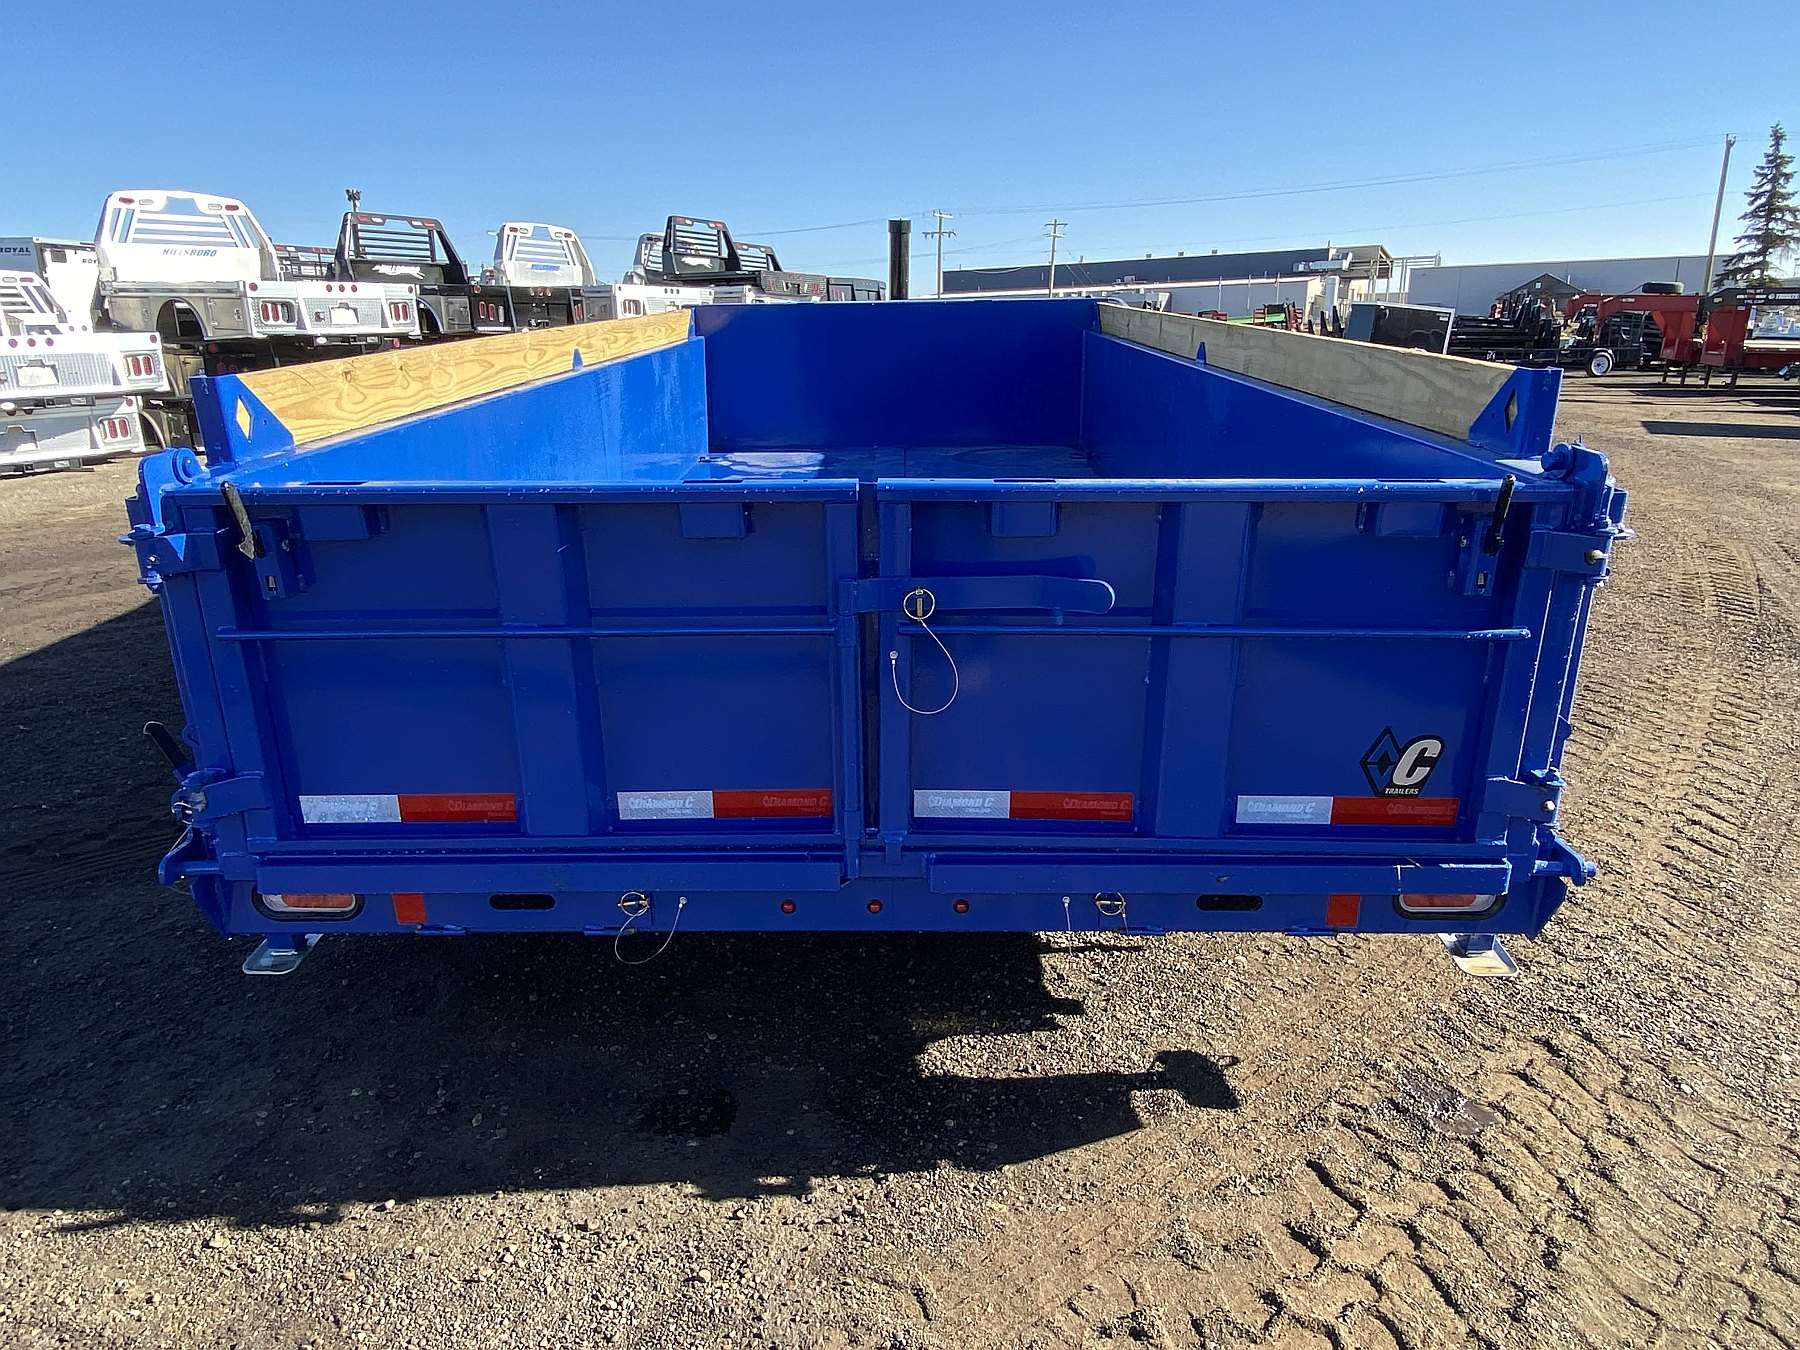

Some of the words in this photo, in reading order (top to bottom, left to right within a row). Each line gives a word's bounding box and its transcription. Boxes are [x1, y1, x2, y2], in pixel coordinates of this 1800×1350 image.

[1392, 739, 1441, 786] C
[1384, 787, 1420, 795] TRAILERS
[934, 797, 983, 808] DIAMOND
[984, 797, 994, 807] C
